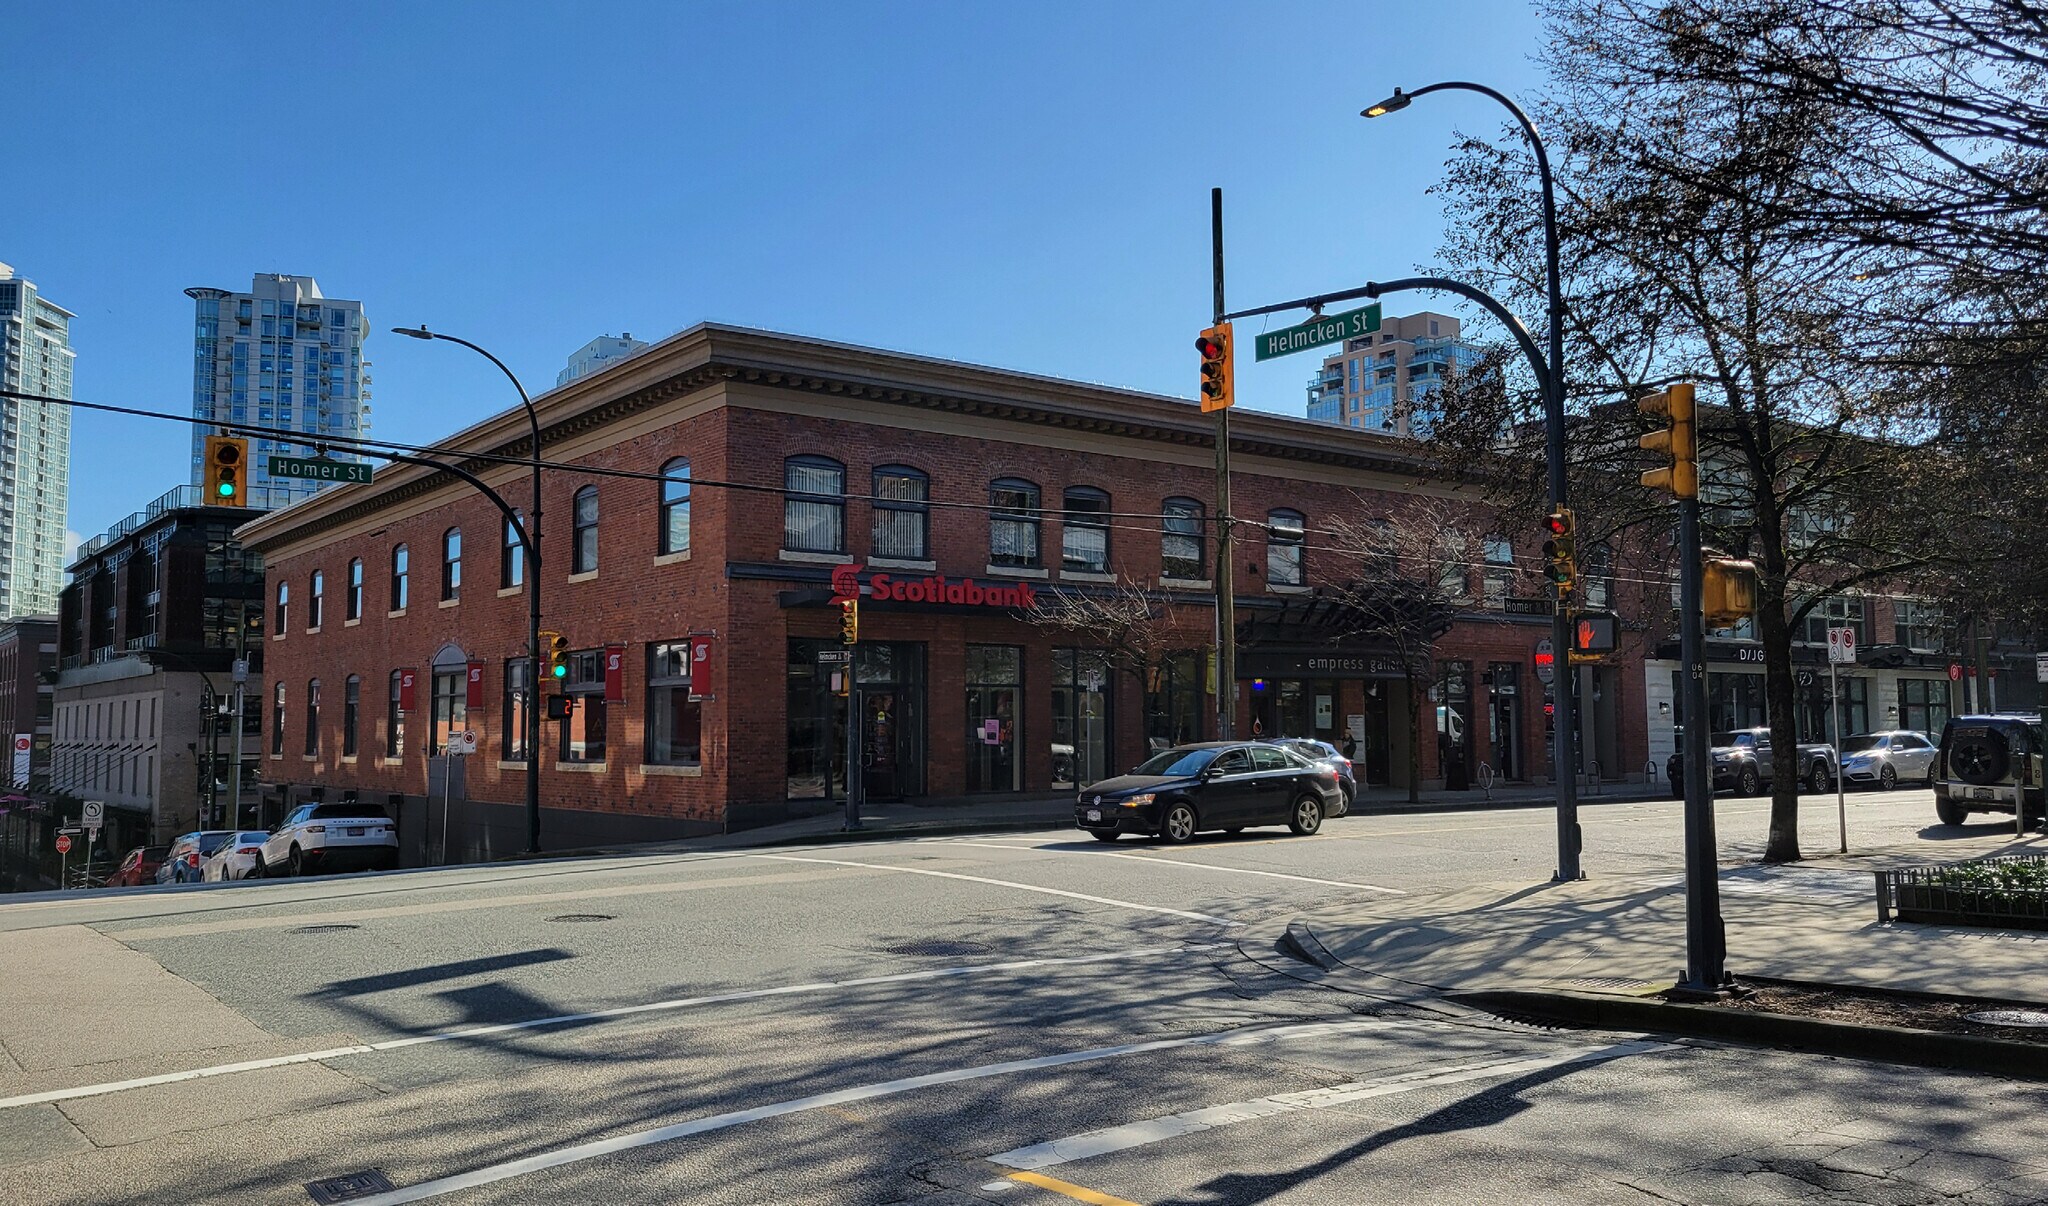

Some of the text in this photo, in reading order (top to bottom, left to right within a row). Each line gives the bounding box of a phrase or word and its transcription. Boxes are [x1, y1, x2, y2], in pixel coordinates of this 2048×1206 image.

[1268, 311, 1368, 355] Helmcken St
[278, 460, 364, 481] Homer St
[870, 573, 1036, 608] Scotiabank
[1506, 600, 1532, 613] Homer
[1308, 656, 1405, 673] empress galler
[564, 699, 571, 714] 2
